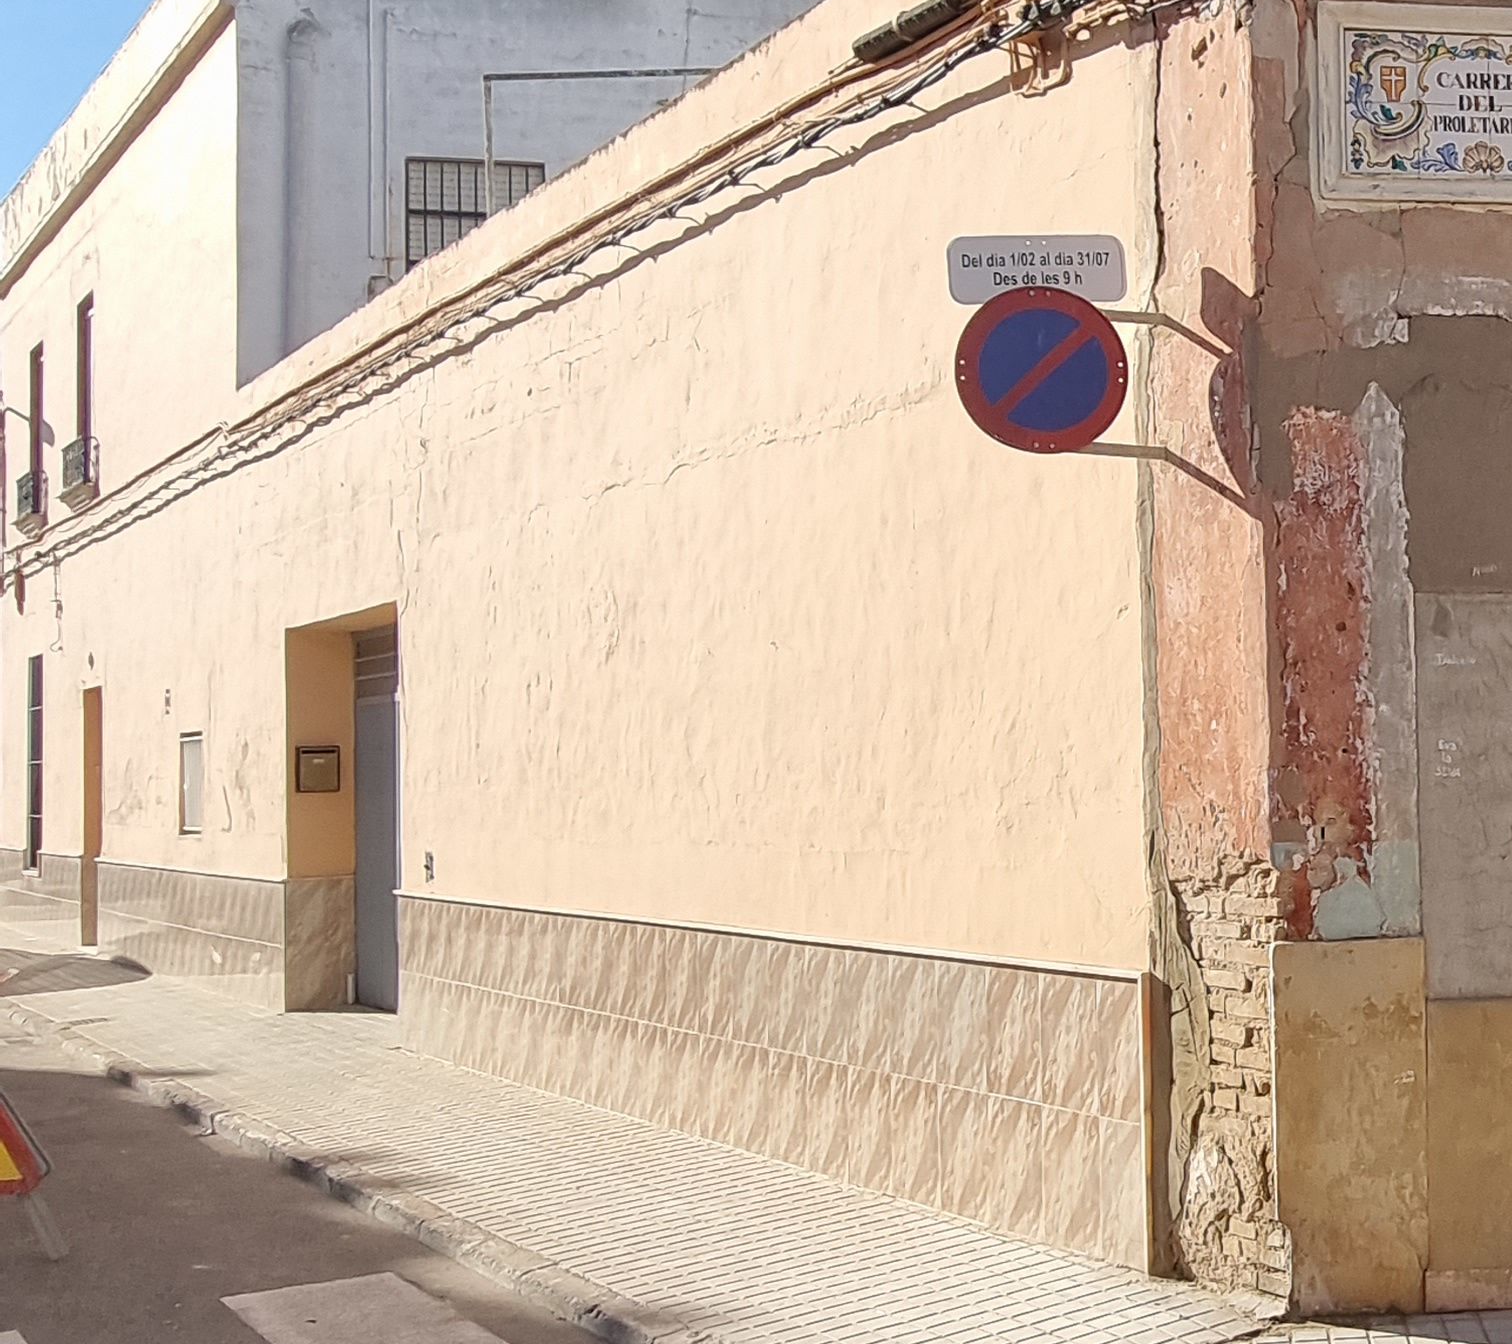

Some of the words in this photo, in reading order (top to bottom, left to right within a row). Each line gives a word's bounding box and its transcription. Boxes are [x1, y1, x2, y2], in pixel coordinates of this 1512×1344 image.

[1458, 94, 1503, 113] DEL
[961, 253, 983, 268] Del
[1010, 252, 1036, 267] 1/02
[1039, 251, 1051, 266] al
[1077, 251, 1109, 266] 31/07
[993, 272, 1018, 286] Des
[1022, 271, 1037, 285] de
[1041, 271, 1060, 285] les
[1063, 270, 1071, 285] 9
[1074, 270, 1083, 285] h
